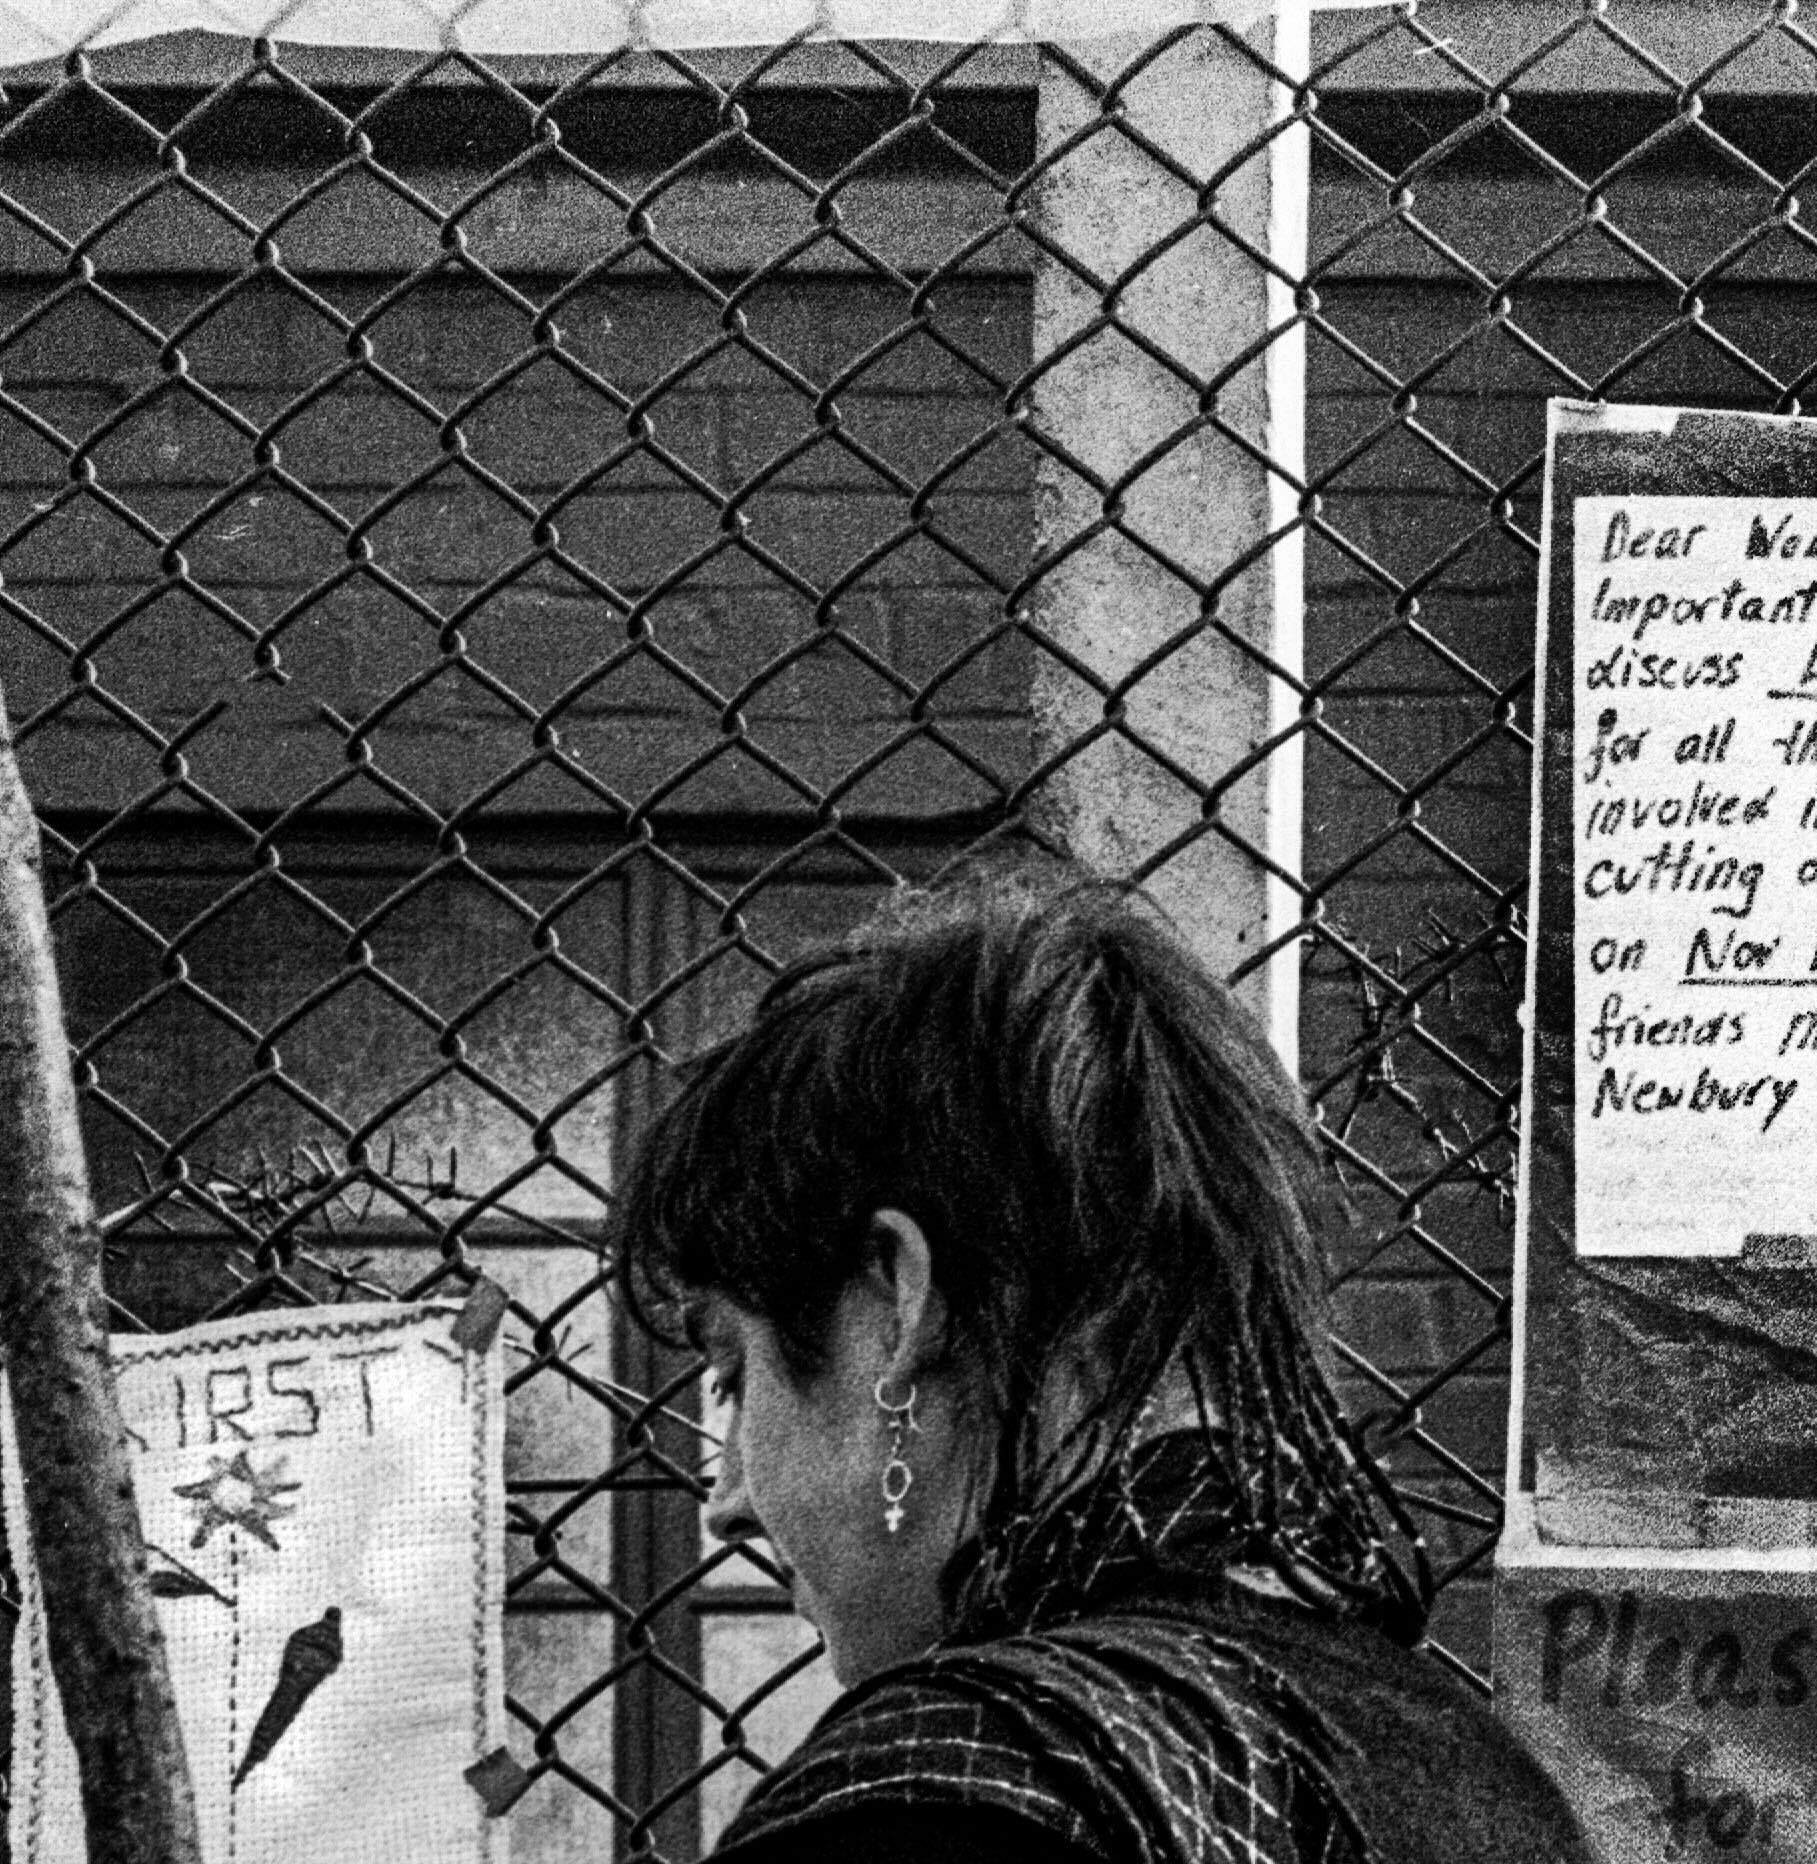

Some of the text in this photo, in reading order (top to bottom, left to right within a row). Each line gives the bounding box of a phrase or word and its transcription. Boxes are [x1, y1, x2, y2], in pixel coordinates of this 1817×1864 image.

[1600, 509, 1707, 562] Dear
[1586, 645, 1744, 690] discuss
[1583, 708, 1651, 784] for
[1674, 716, 1736, 767] all
[1586, 778, 1776, 840] involved
[1584, 839, 1764, 918] cutting
[1590, 937, 1647, 973] on
[1589, 992, 1747, 1063] friends
[1590, 1066, 1799, 1132] Newbury
